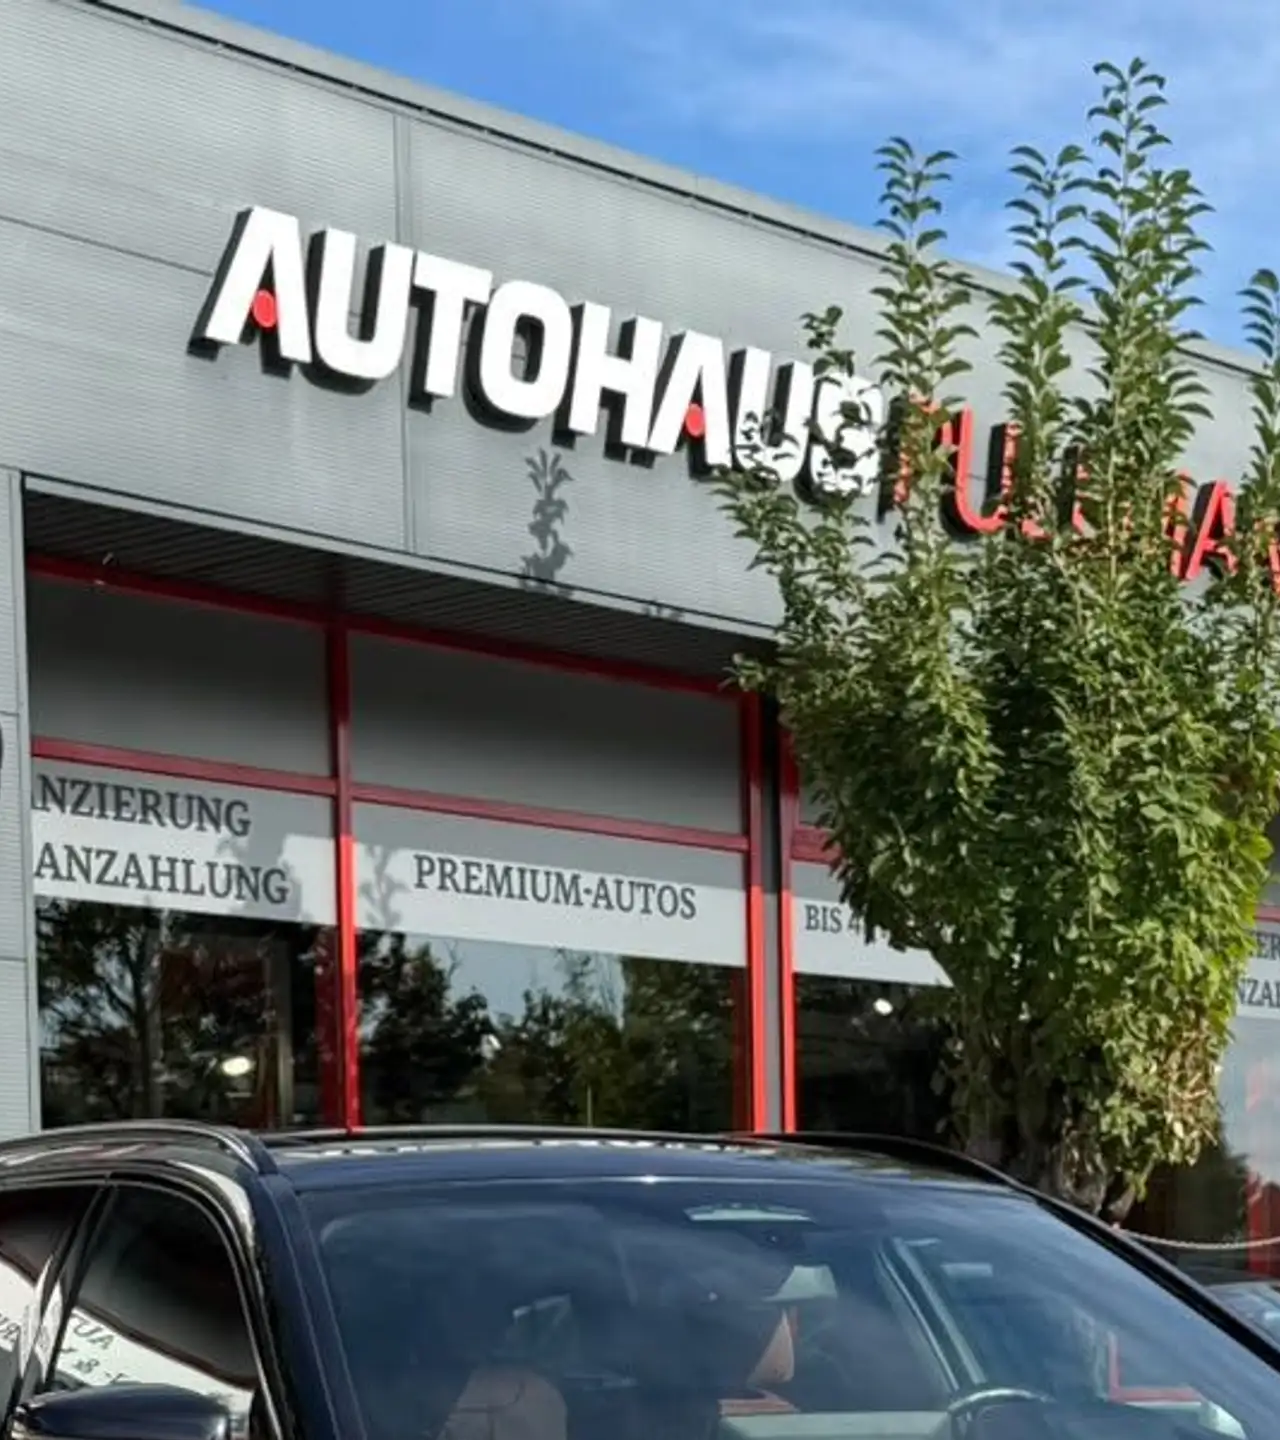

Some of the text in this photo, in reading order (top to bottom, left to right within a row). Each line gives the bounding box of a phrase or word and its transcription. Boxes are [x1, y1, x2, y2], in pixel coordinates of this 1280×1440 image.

[200, 205, 885, 497] AUTOHAUS
[31, 774, 252, 837] NZIERUNG
[34, 842, 289, 904] ANZAHLUNG
[413, 853, 697, 920] PREMIUM-AUTOS
[805, 903, 843, 934] BIS
